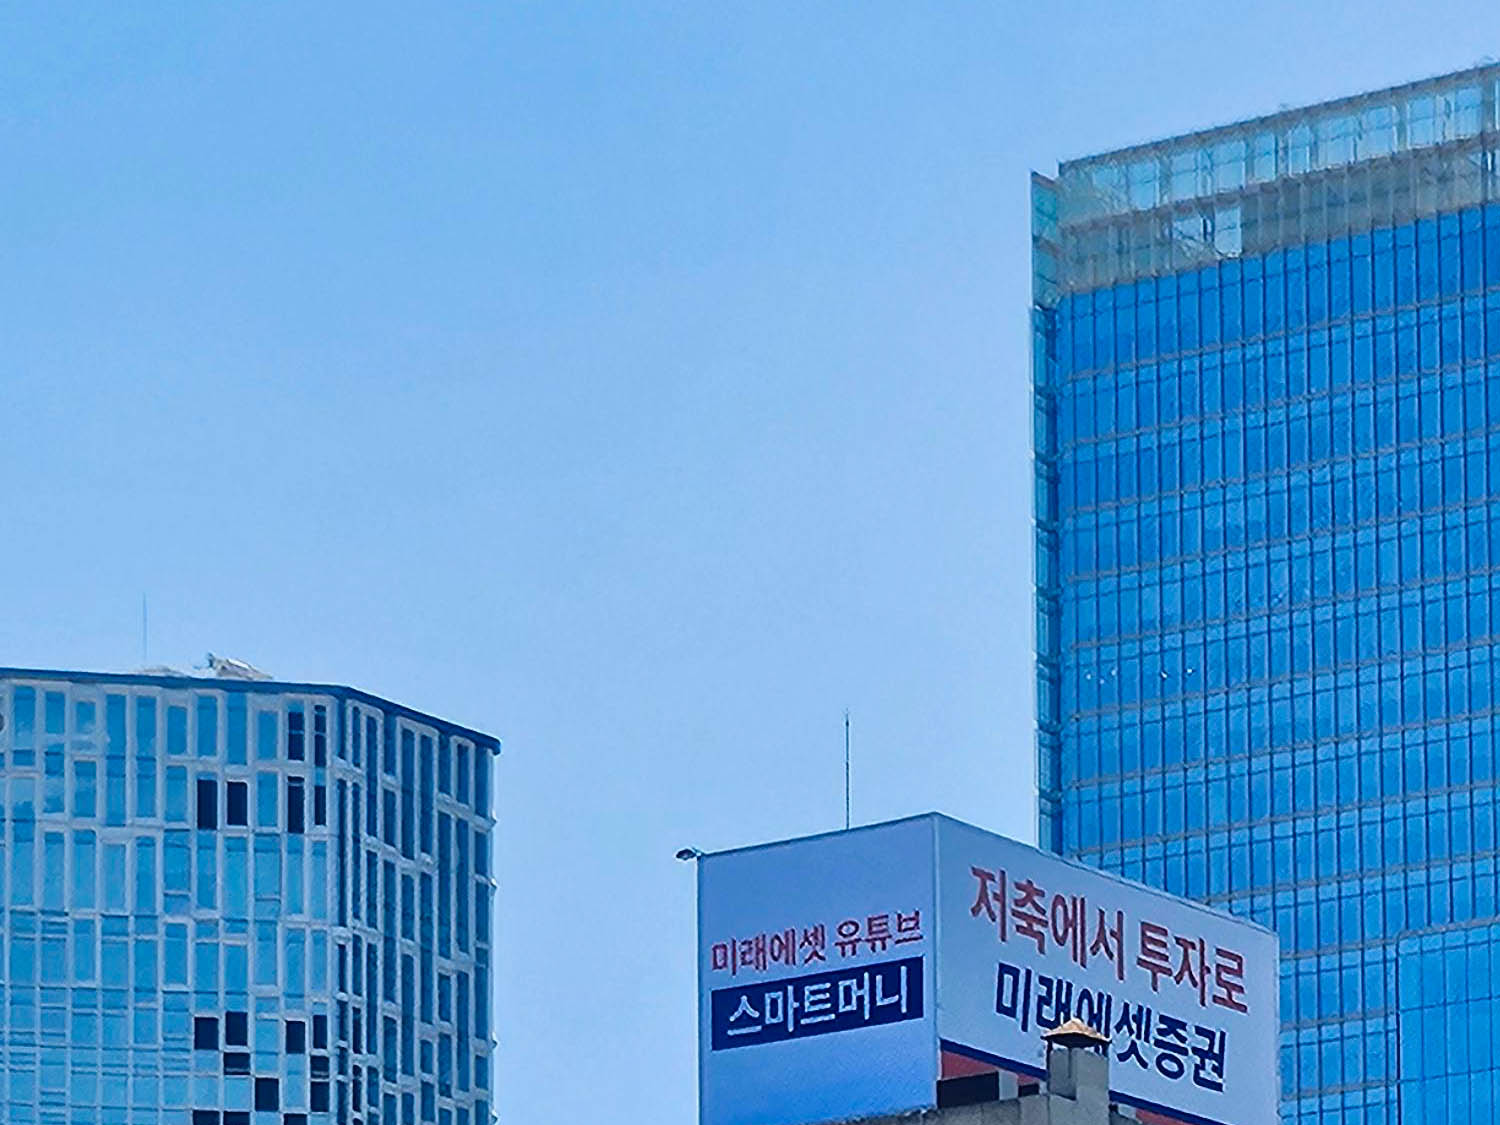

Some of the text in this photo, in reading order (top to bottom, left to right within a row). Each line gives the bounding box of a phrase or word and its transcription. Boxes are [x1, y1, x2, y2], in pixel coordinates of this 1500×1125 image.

[711, 908, 924, 976] 미래에셋 유튜브
[970, 866, 1249, 1013] 저축에서 투자로
[727, 965, 908, 1033] 스마트머니
[995, 962, 1227, 1093] 미래에셋증권
